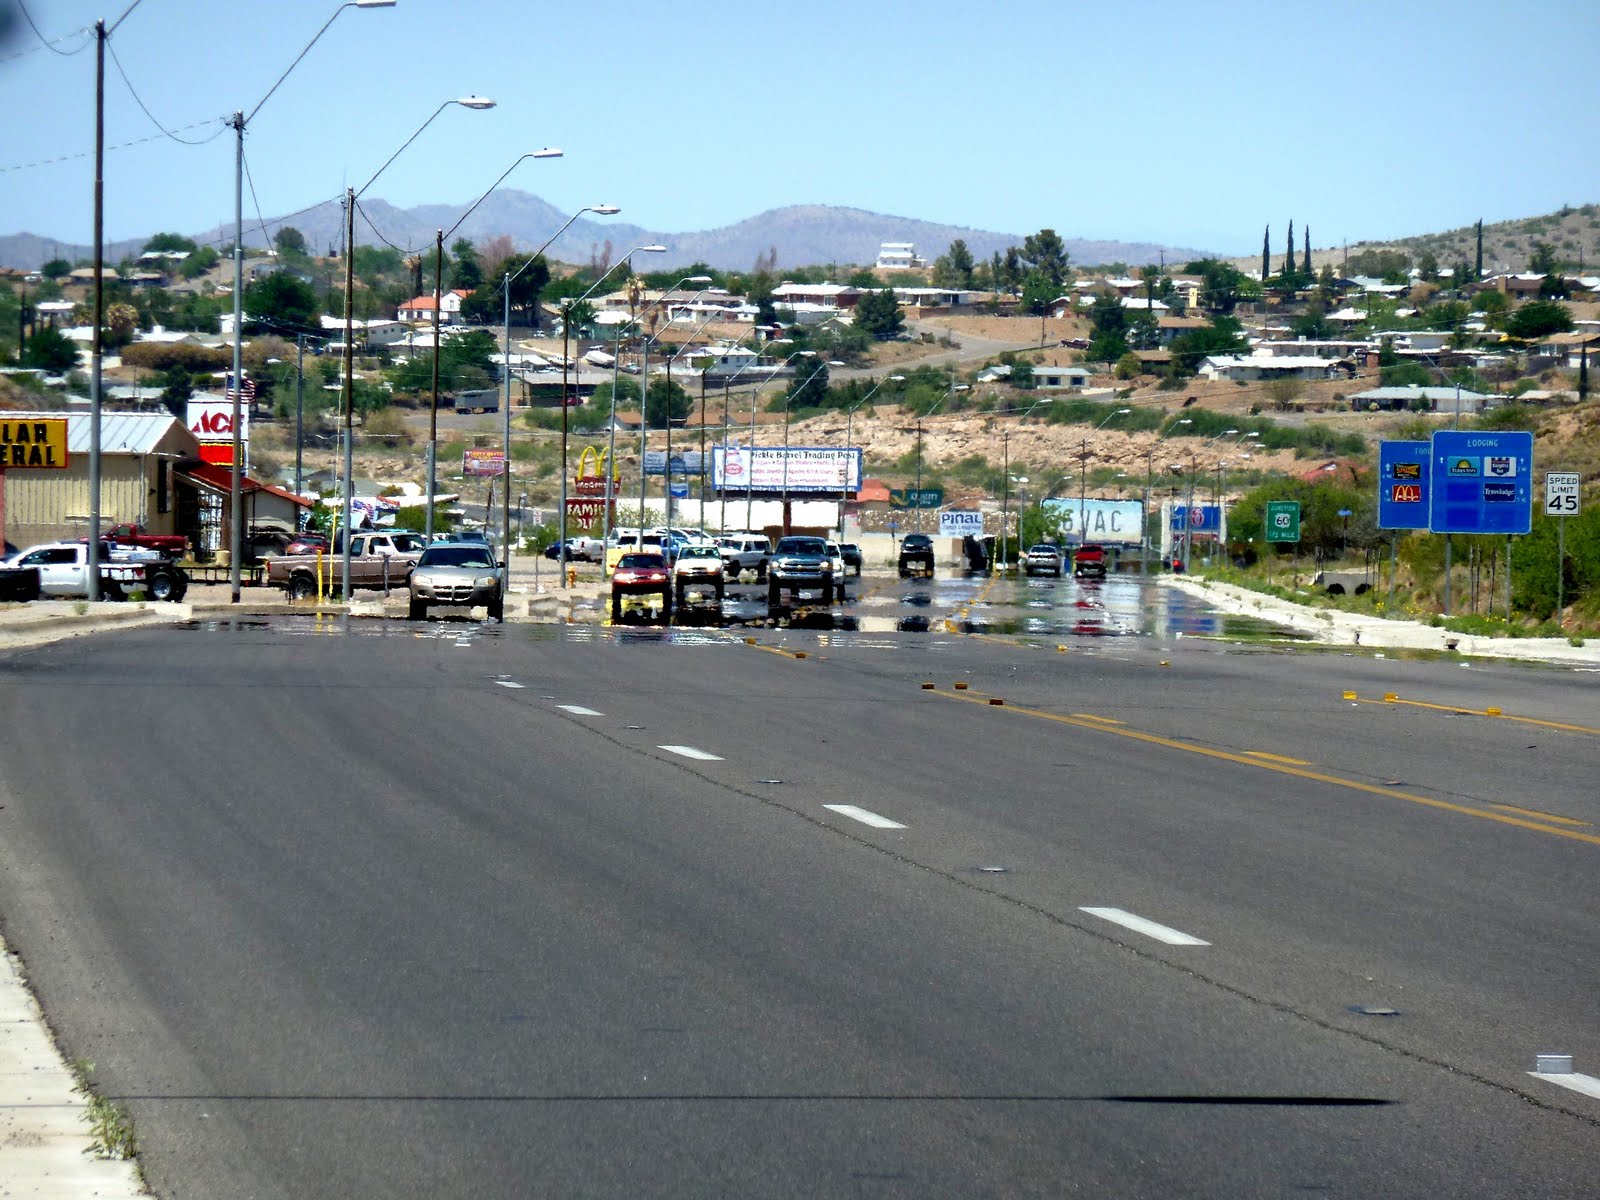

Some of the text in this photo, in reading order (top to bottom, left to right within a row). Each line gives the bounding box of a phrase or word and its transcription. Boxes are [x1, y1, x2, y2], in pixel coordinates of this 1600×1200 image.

[1467, 439, 1499, 448] LODGING
[803, 451, 835, 461] Trading
[1549, 477, 1578, 485] SPEED
[1548, 495, 1577, 511] 45
[1281, 531, 1296, 539] MILE
